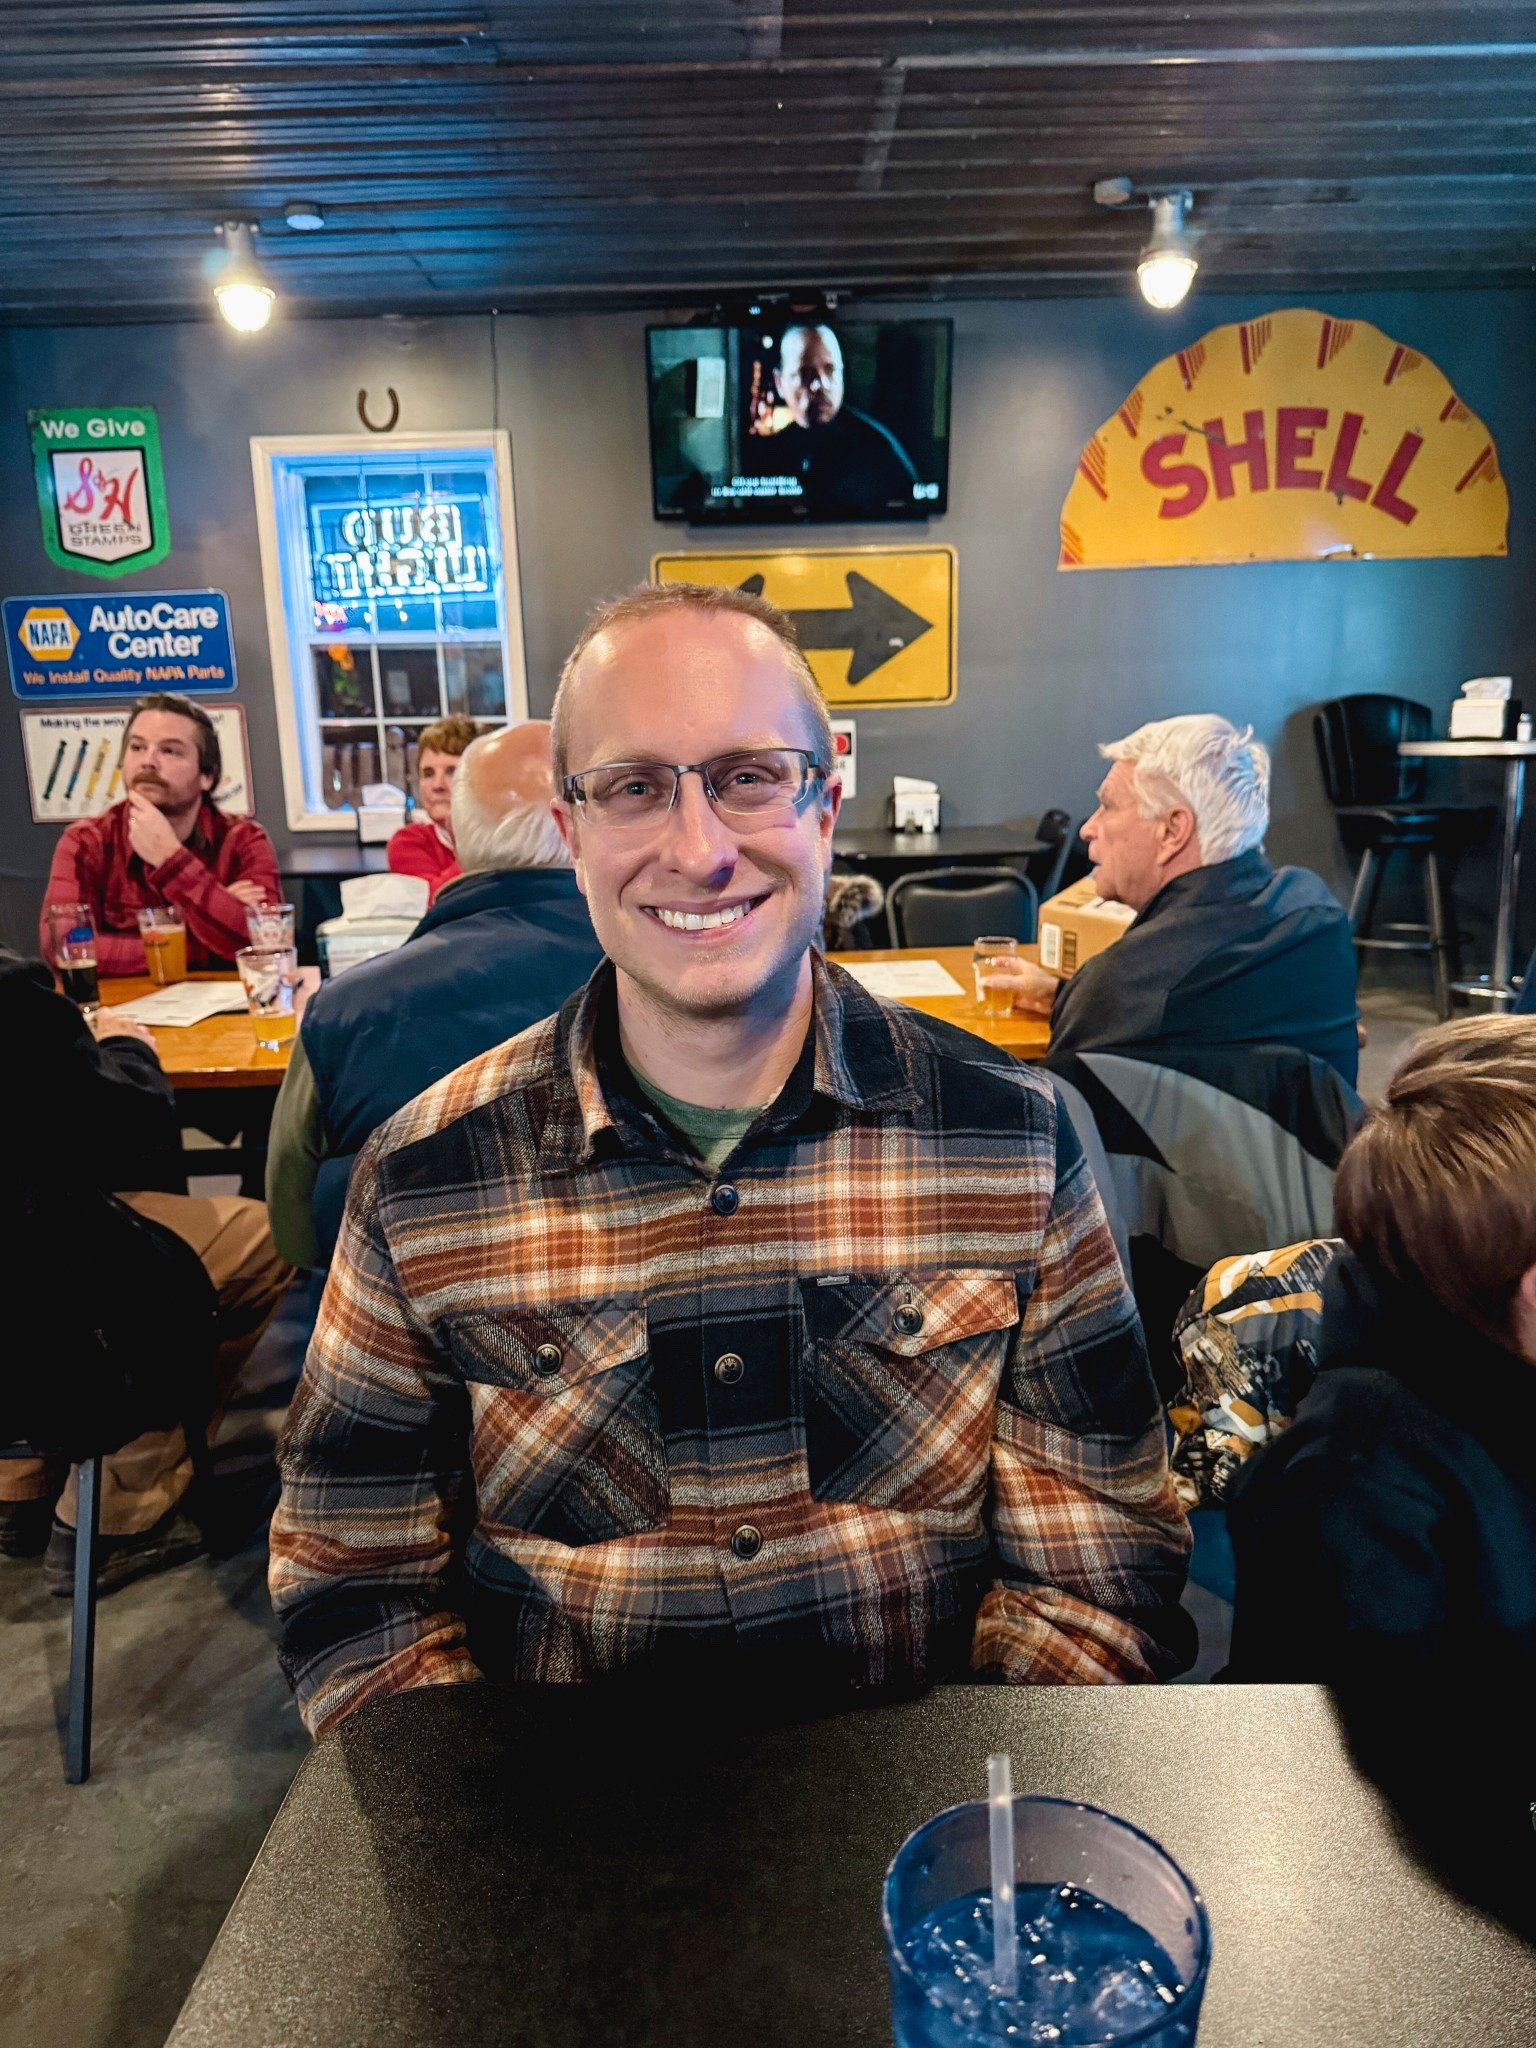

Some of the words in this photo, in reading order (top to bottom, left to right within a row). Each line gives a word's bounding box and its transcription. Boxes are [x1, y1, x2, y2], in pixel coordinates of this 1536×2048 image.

[40, 420, 80, 439] We
[86, 418, 146, 438] Give
[1140, 407, 1424, 526] SHELL
[69, 522, 142, 536] GREEN
[71, 535, 142, 547] STAMPS
[89, 602, 219, 633] AutoCare
[28, 621, 71, 648] NAPA
[108, 630, 203, 660] Center
[23, 671, 45, 685] We
[49, 668, 90, 684] Install
[93, 667, 143, 684] Quality
[145, 666, 186, 681] NAPA
[187, 664, 226, 679] Parts
[40, 718, 81, 730] Making
